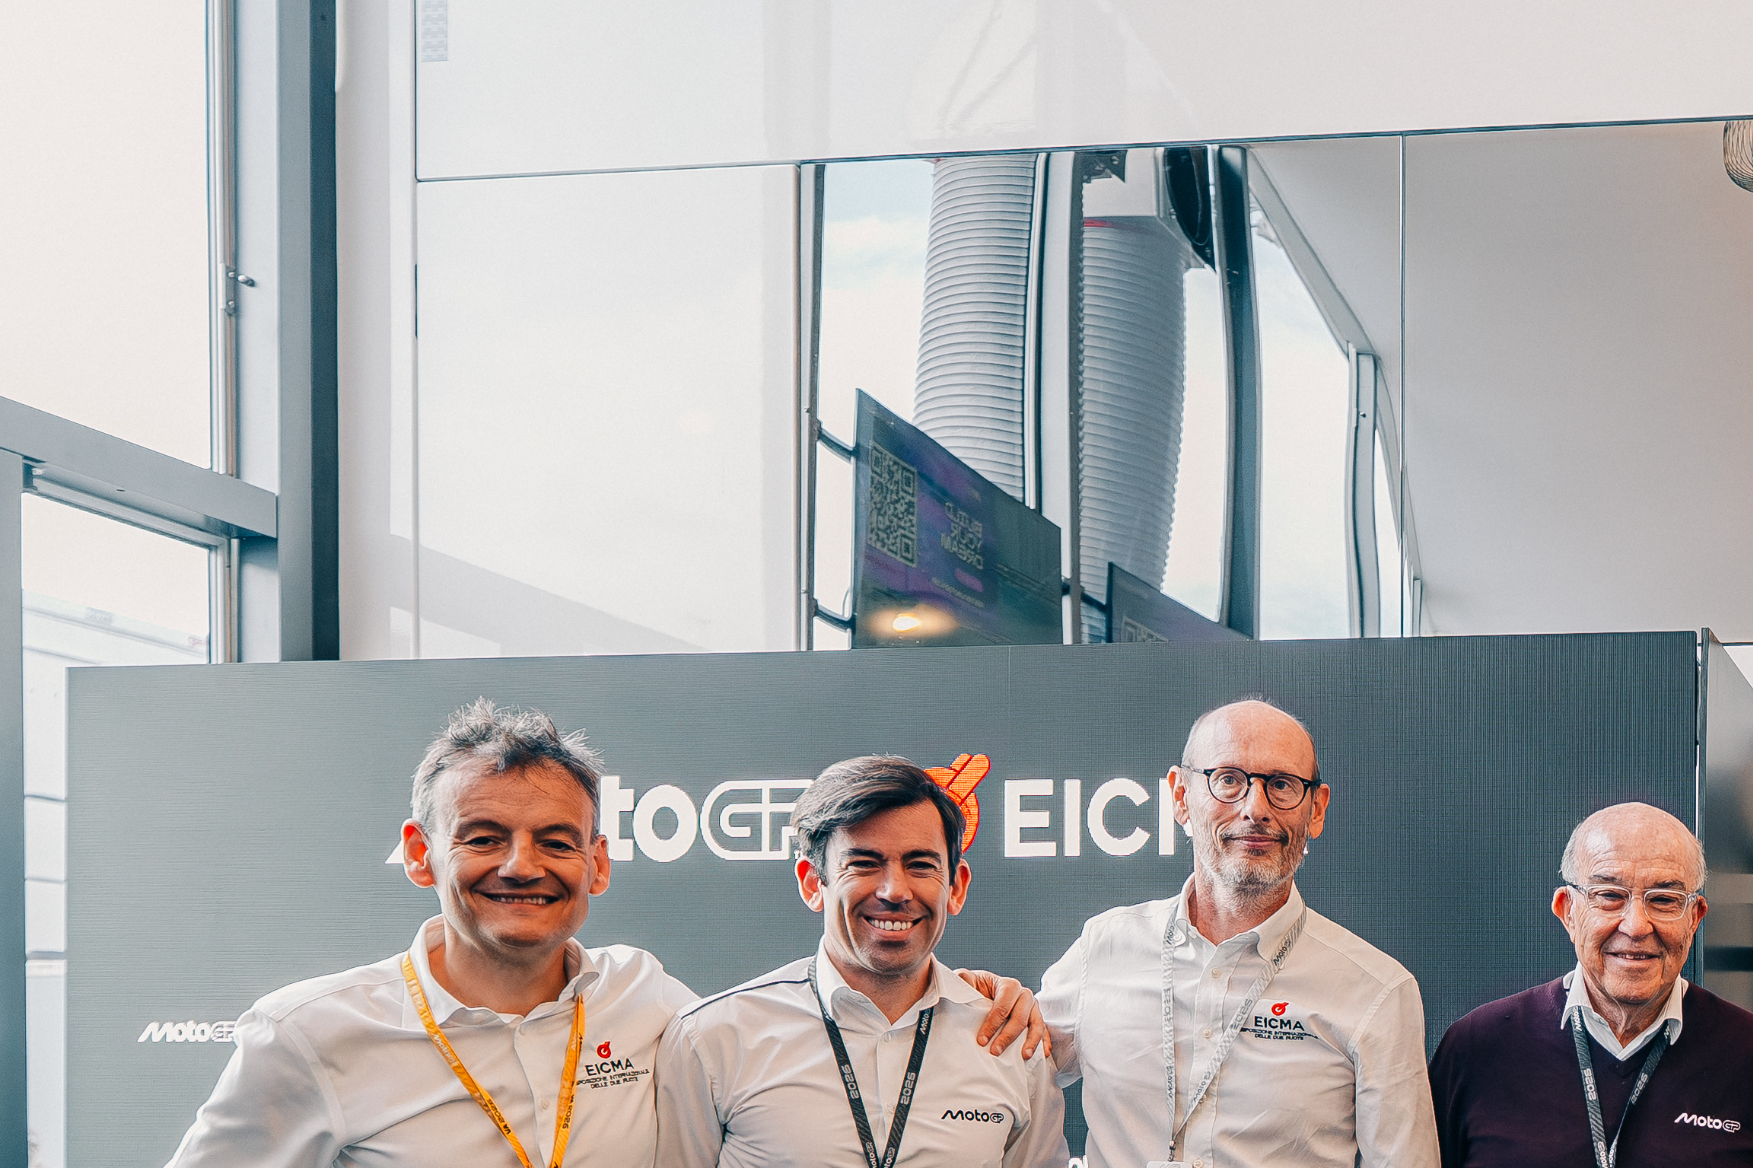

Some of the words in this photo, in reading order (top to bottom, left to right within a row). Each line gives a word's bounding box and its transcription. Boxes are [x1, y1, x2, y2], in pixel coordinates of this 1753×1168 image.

[1004, 777, 1193, 858] EIC
[1254, 1015, 1305, 1031] EICMA
[584, 1057, 634, 1076] EICMA
[941, 1109, 1004, 1124] MotoGP
[1674, 1112, 1741, 1133] MotoGP
